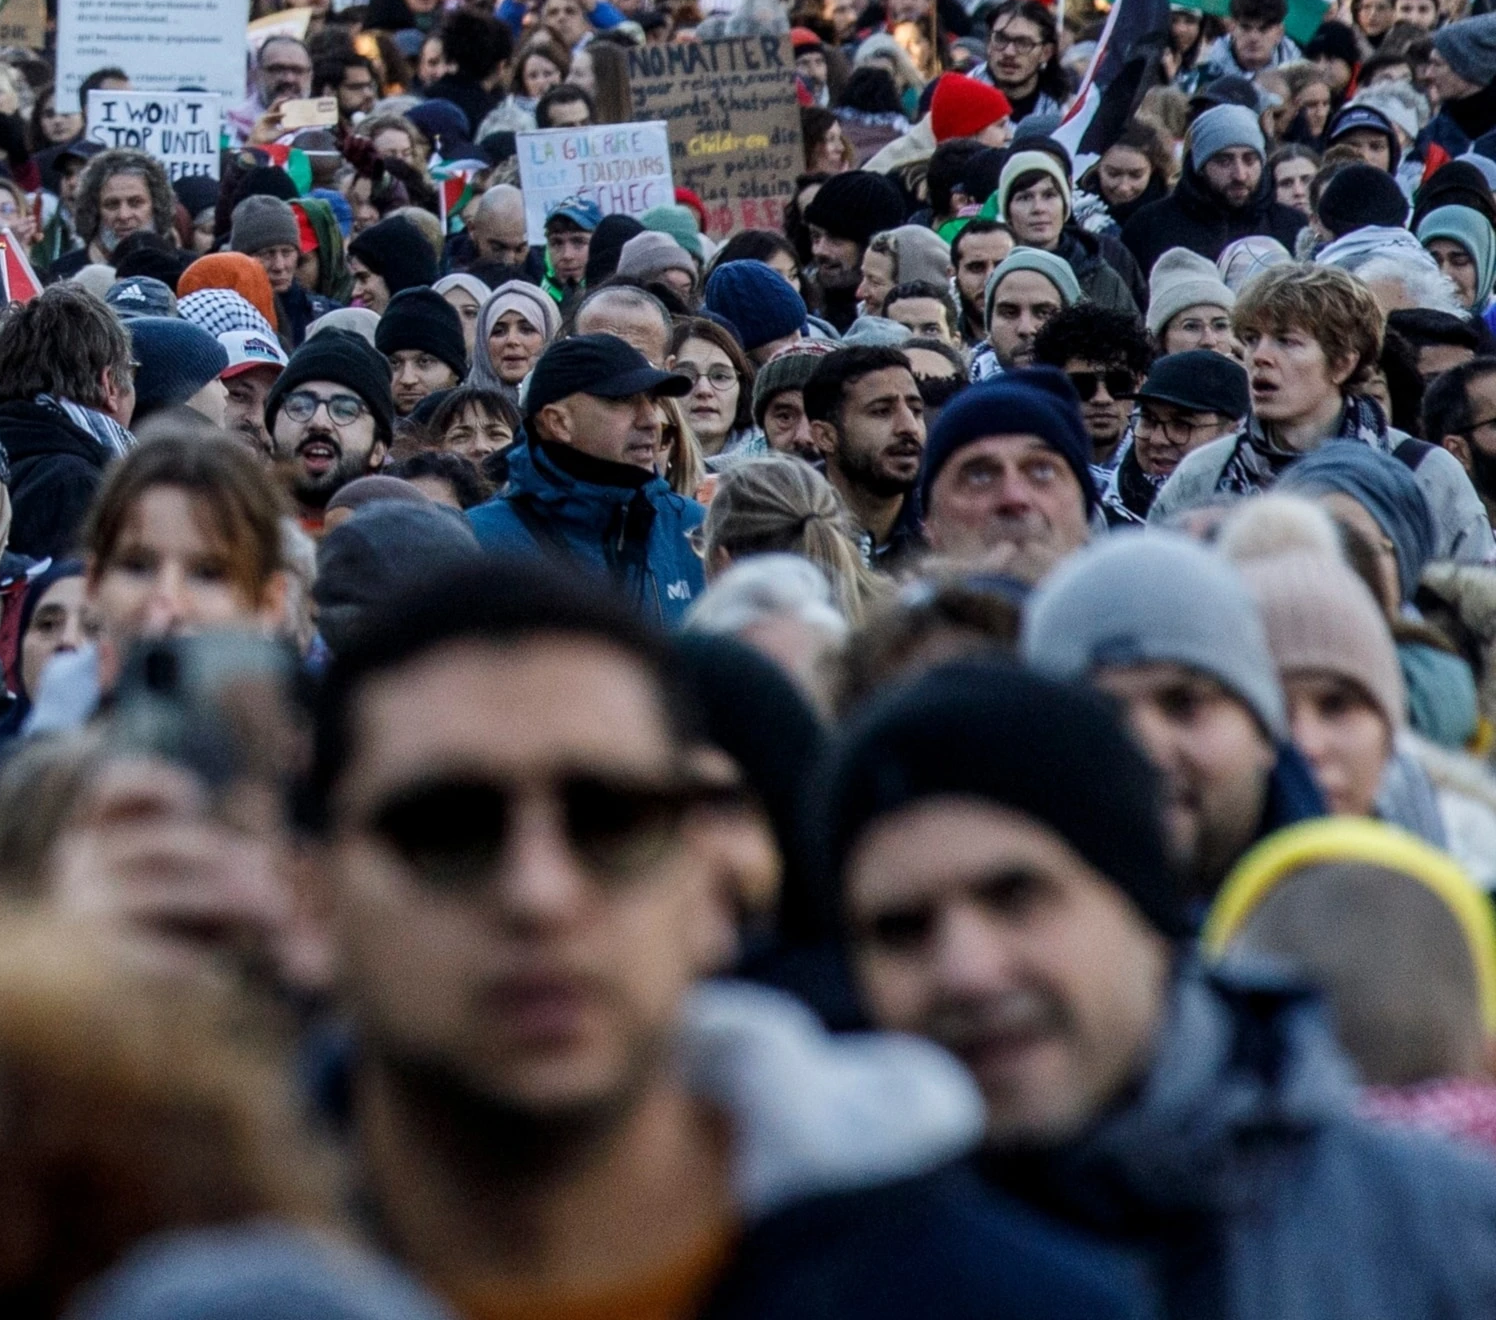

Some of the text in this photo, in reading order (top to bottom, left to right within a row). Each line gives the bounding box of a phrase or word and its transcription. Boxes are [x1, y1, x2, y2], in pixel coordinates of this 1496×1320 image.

[102, 98, 203, 125] I WON'T
[91, 125, 216, 155] STOP UNTIL
[529, 141, 556, 165] LA
[562, 131, 645, 161] GUERRE
[578, 155, 665, 184] TOUJOURS
